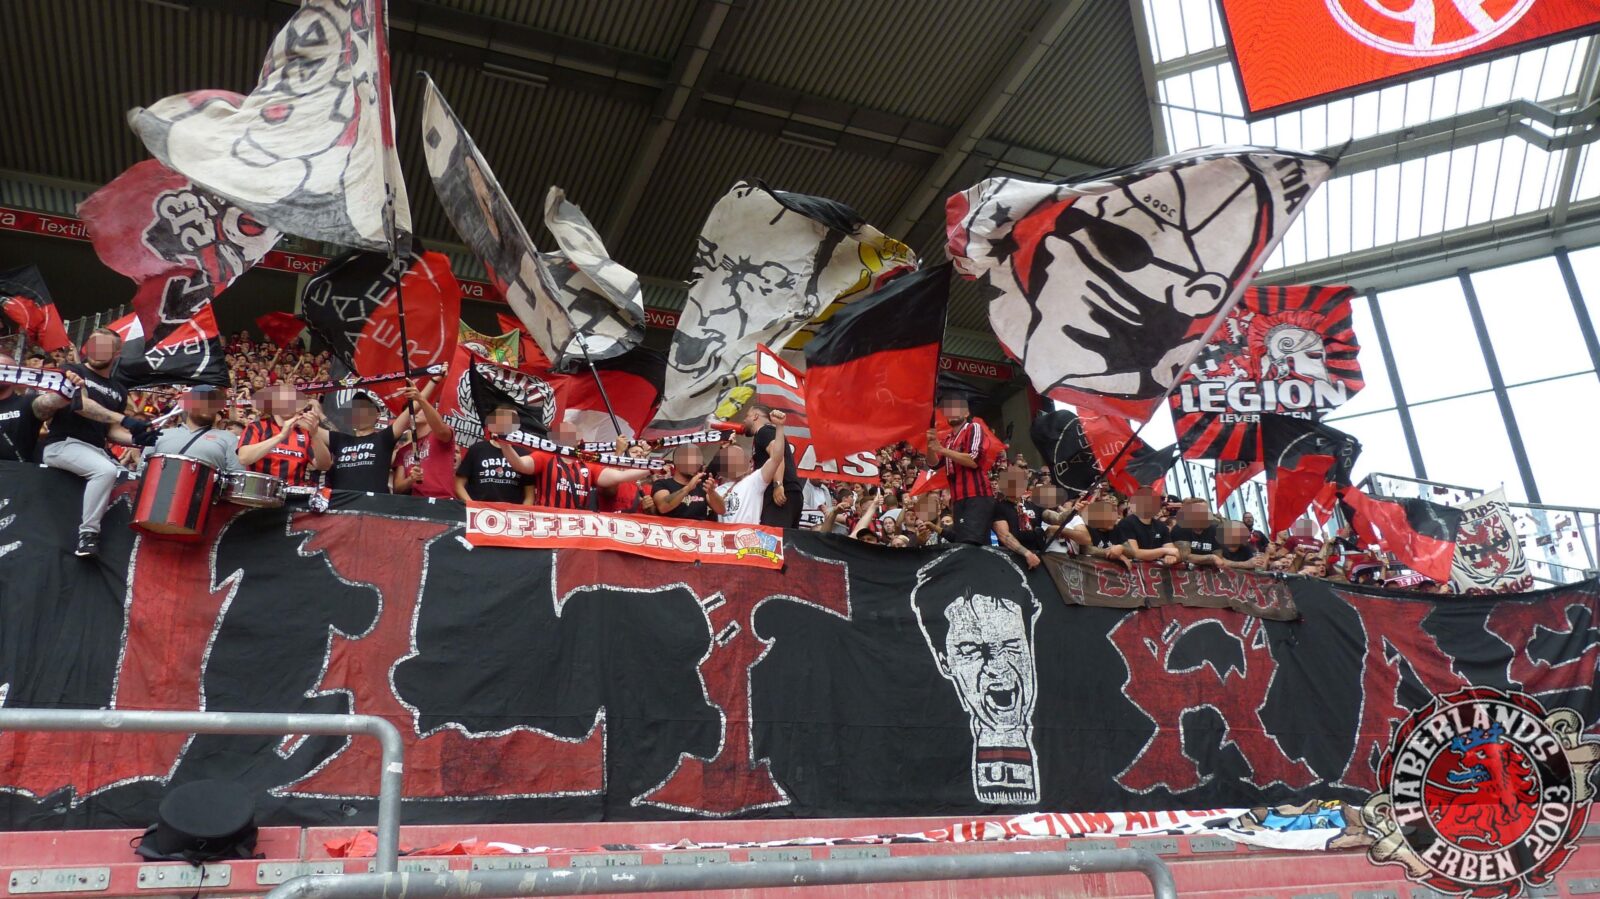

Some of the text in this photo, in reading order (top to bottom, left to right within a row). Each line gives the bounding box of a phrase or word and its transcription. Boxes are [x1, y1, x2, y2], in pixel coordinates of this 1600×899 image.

[643, 311, 676, 326] ewa
[1180, 379, 1348, 413] LEGION
[474, 508, 726, 554] OFFENBACH
[984, 765, 1027, 785] UL
